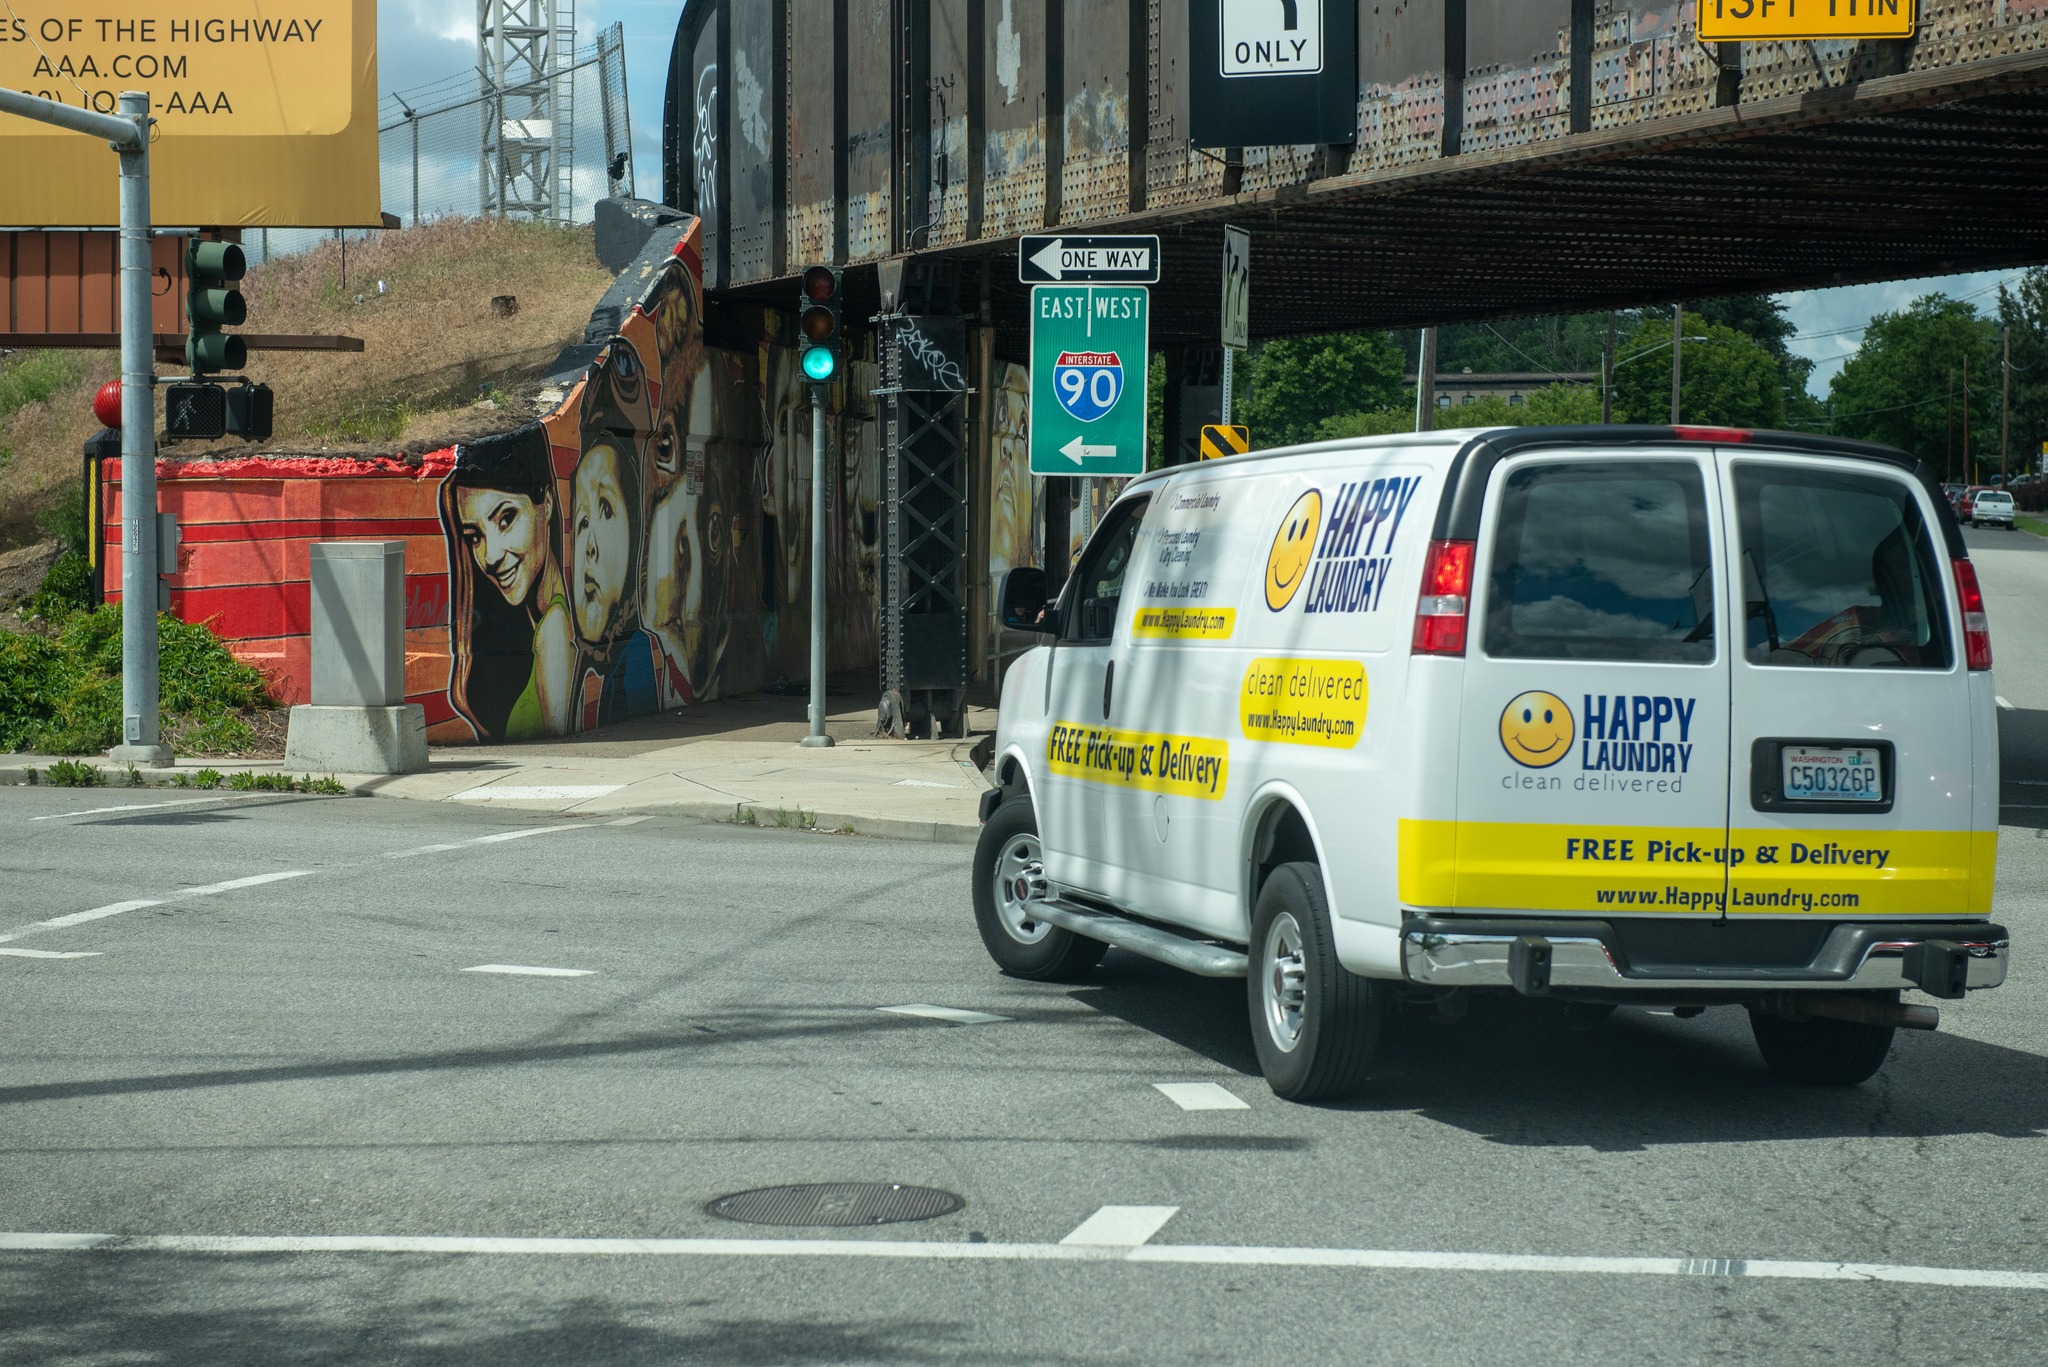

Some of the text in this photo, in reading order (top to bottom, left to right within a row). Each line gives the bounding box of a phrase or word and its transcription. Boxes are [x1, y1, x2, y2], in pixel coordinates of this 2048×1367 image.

[40, 18, 83, 42] OF
[95, 19, 156, 42] THE
[170, 18, 323, 42] HIGHWAY
[1235, 38, 1307, 64] ONLY
[33, 55, 187, 79] AAA.COM
[1061, 250, 1144, 268] ONE WAY
[1041, 297, 1142, 319] EAST WEST
[1065, 355, 1112, 365] INTERSTATE
[1060, 369, 1117, 408] 90
[1317, 475, 1422, 559] HAPPY
[1304, 557, 1392, 614] LAUNDRY
[1141, 610, 1225, 635] www.HappyLaundry.com
[1248, 664, 1365, 701] clean delivered
[1248, 709, 1354, 739] www.HappyLaundry.com
[1582, 694, 1697, 743] HAPPY
[1050, 725, 1222, 794] FREE Pick-up & Delivery
[1581, 740, 1694, 774] LAUNDRY
[1790, 756, 1843, 764] WASHINGTON
[1501, 770, 1683, 794] clean delivered
[1790, 766, 1876, 793] C50326P
[1566, 837, 1891, 870] FREE Pick-up & Delivery
